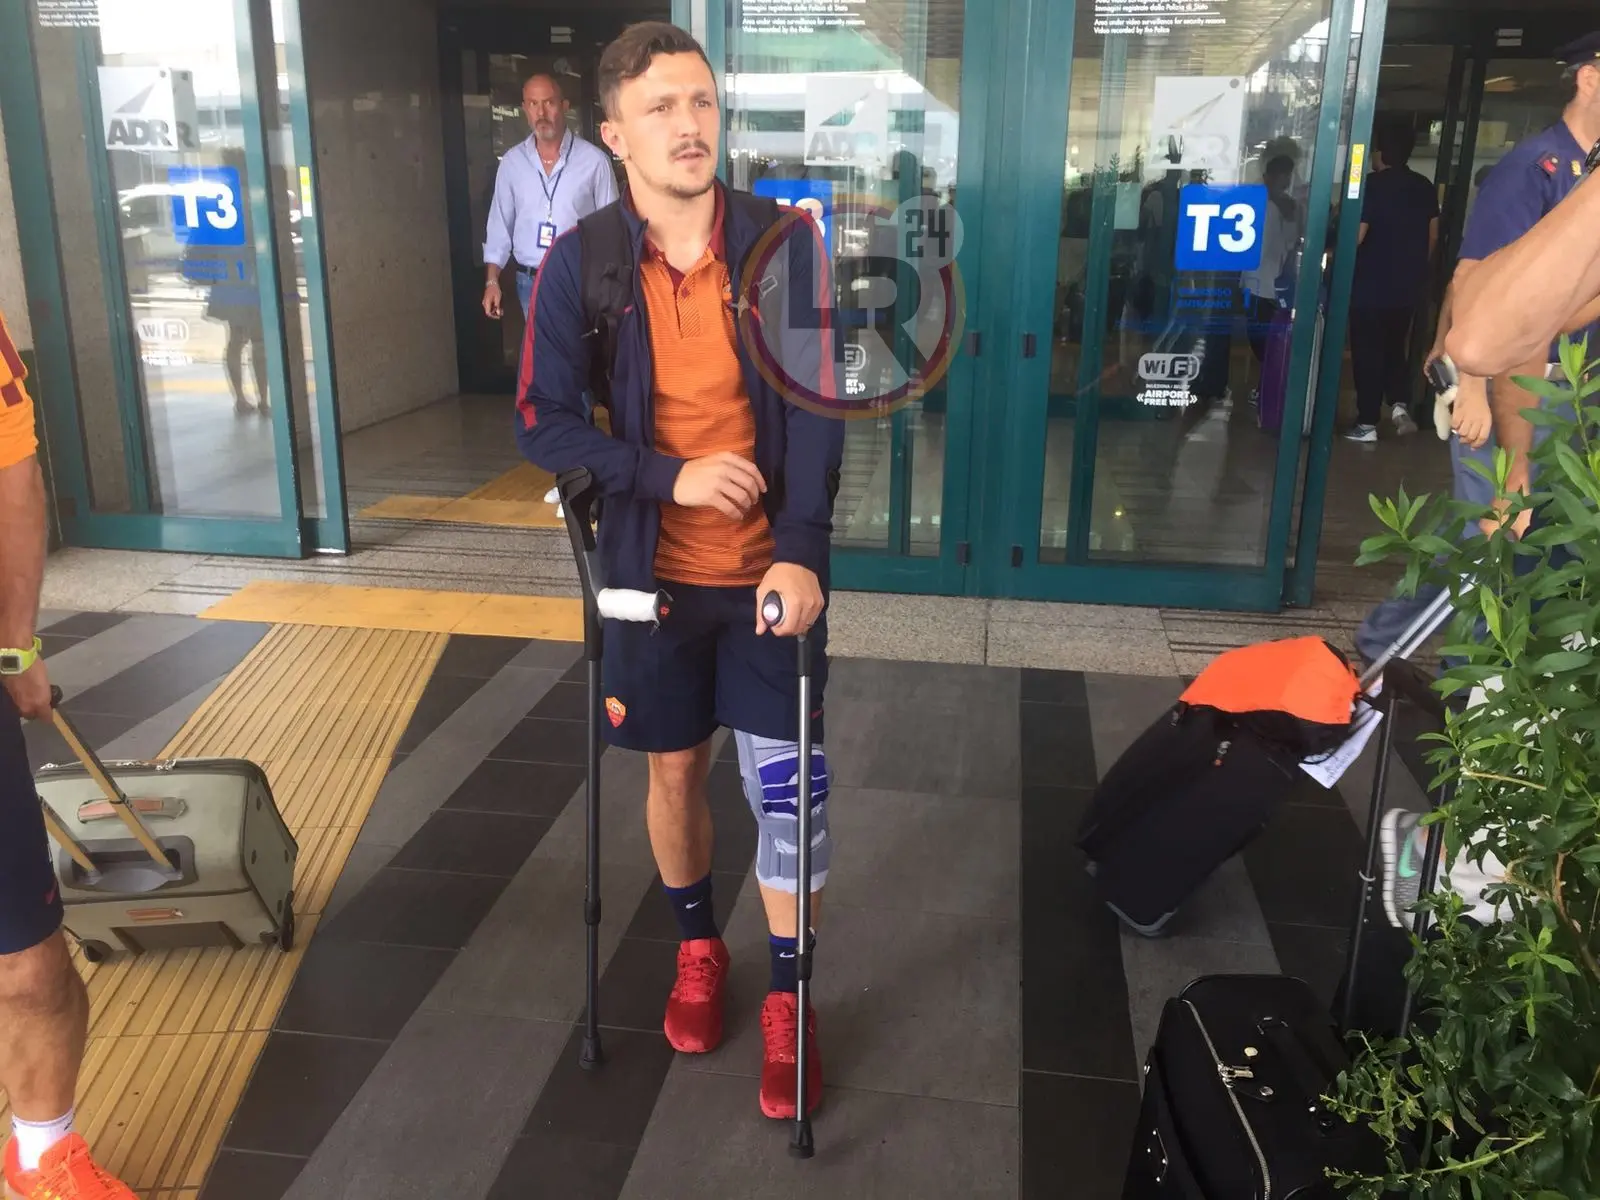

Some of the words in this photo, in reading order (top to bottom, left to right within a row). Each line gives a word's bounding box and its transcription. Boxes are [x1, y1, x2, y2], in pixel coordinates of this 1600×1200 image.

[173, 181, 239, 230] T3
[1186, 203, 1256, 253] T3
[1144, 389, 1190, 399] AIRPORT
[1144, 398, 1167, 406] FREE
[1169, 398, 1189, 407] WIFI
